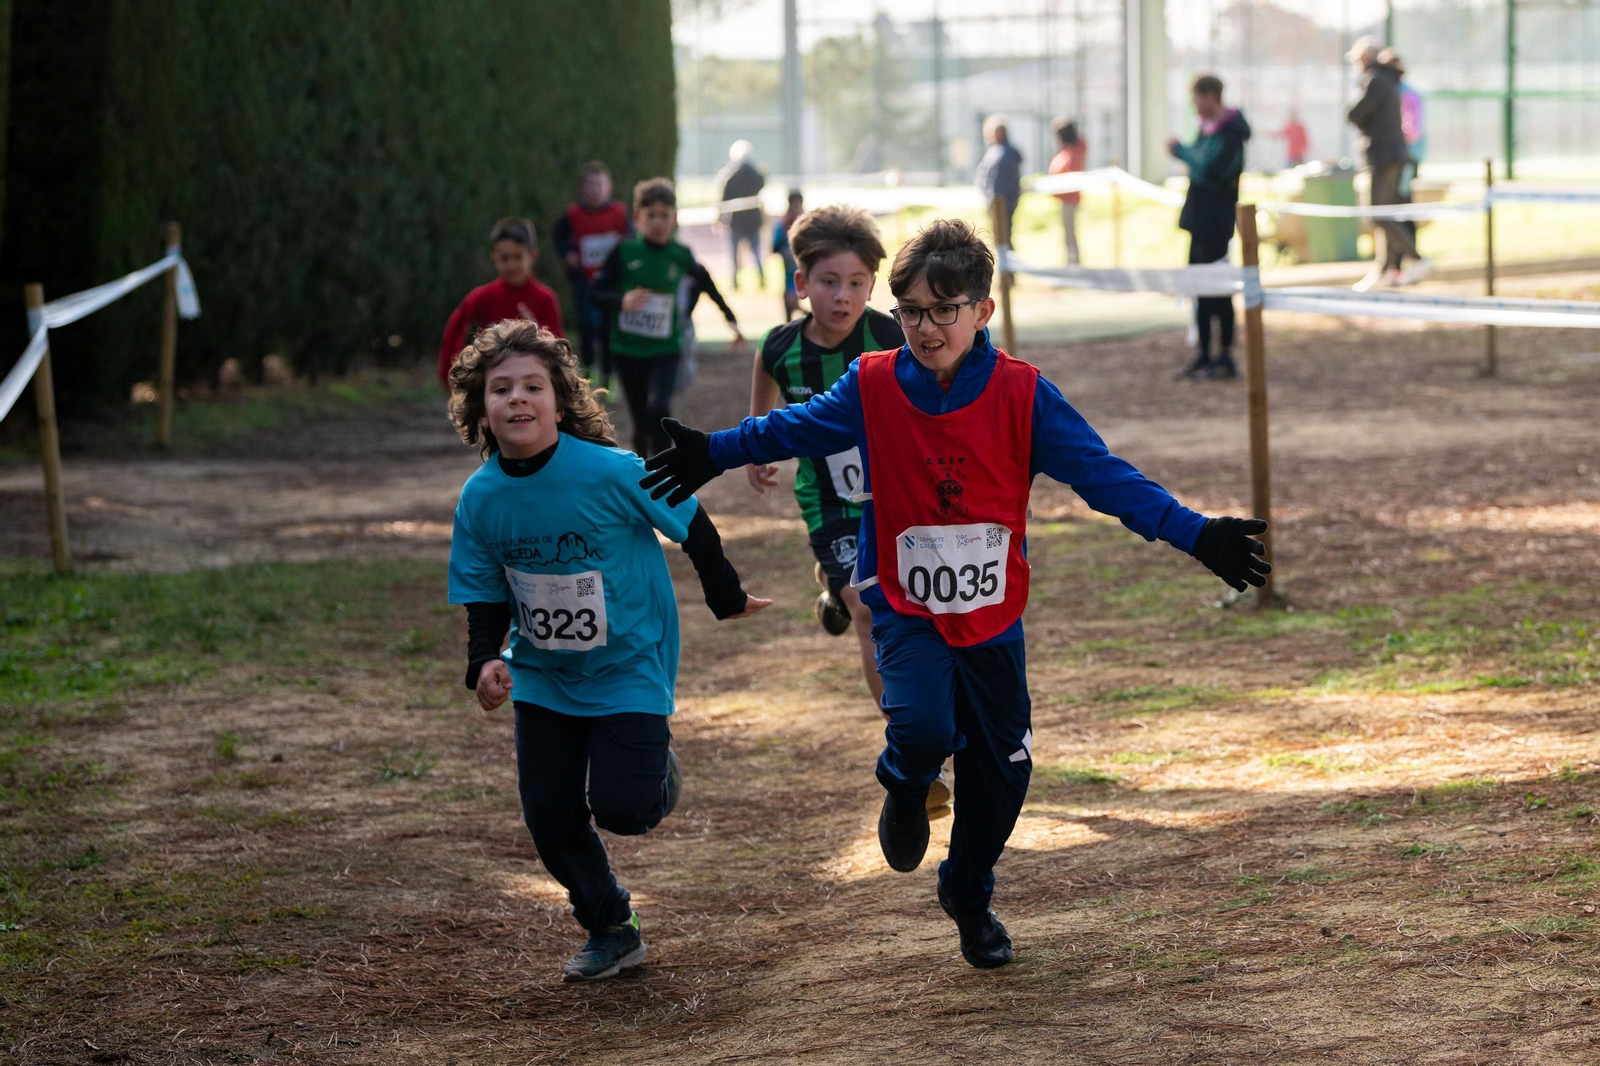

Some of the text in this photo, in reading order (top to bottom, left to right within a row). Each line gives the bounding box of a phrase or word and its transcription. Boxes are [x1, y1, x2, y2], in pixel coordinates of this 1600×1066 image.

[542, 535, 554, 544] DE
[908, 560, 999, 603] 0035
[520, 601, 598, 642] 0323
